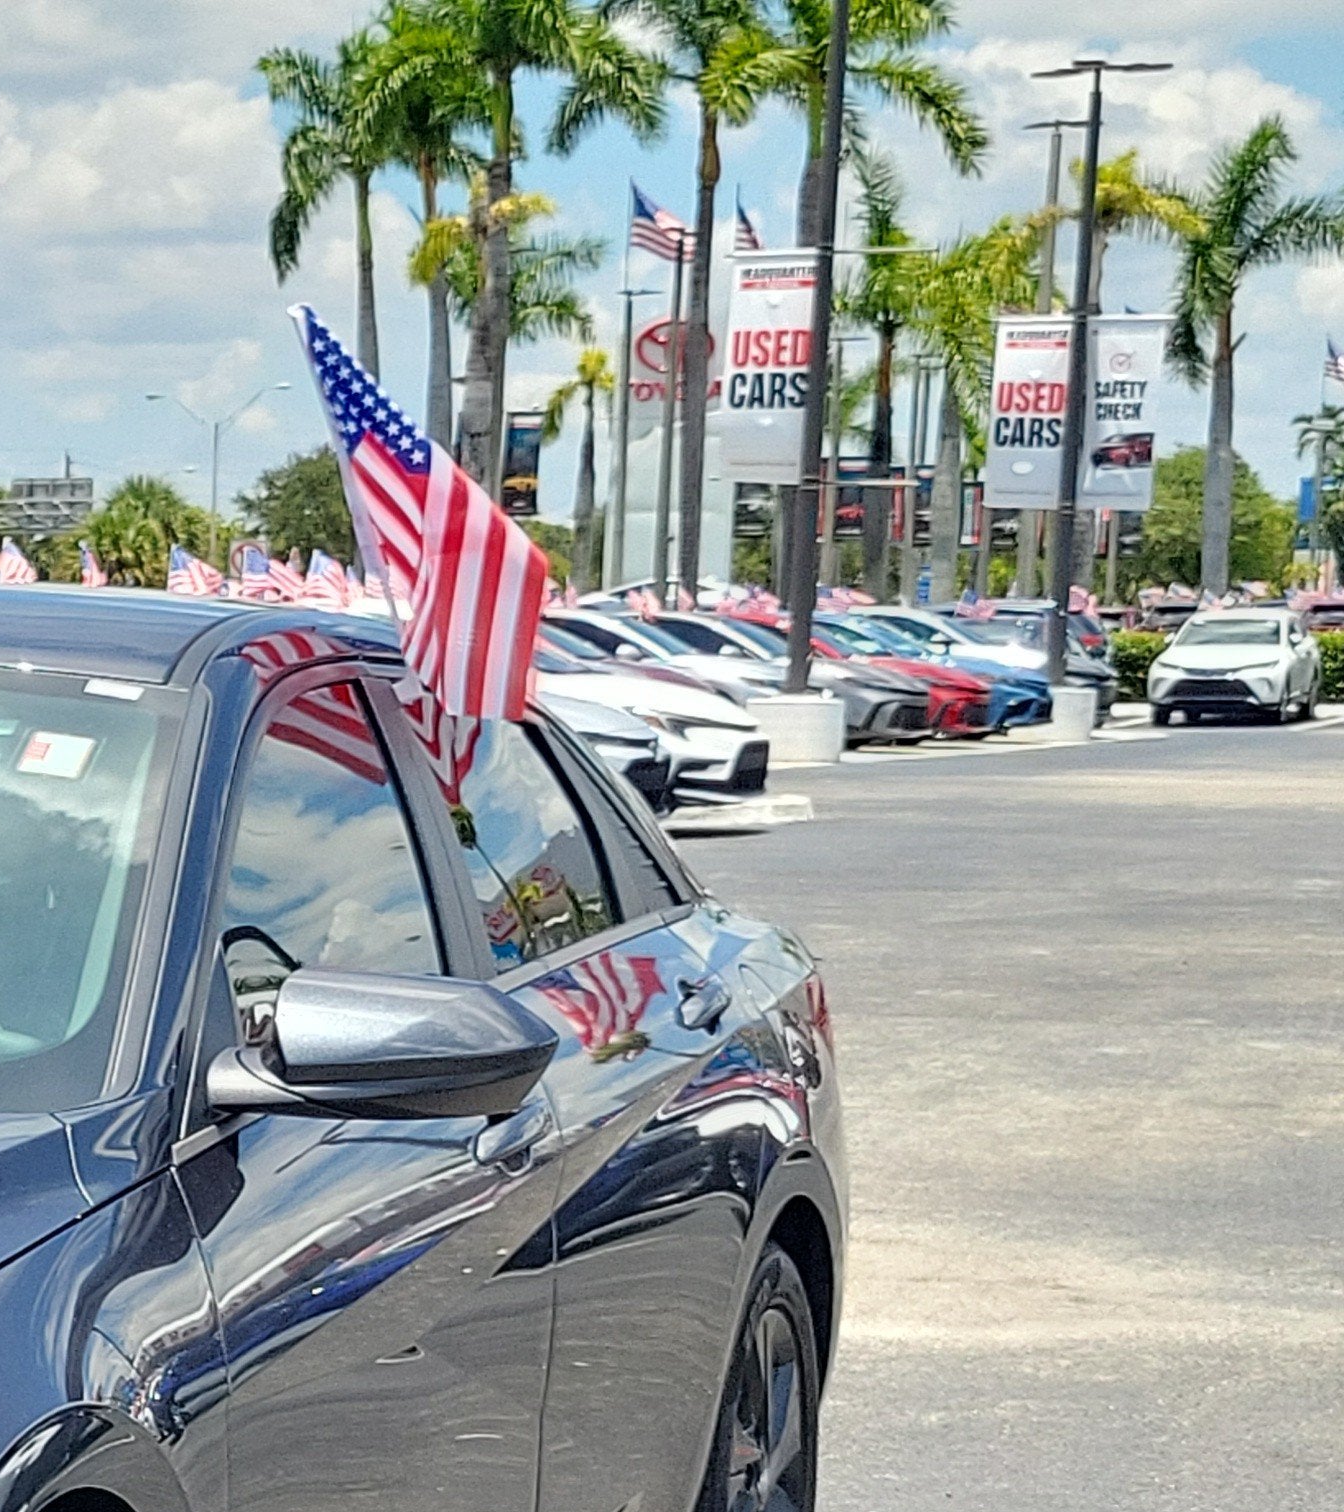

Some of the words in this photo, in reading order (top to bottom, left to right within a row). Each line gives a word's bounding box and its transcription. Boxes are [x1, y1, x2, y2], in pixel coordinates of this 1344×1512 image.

[732, 329, 813, 367] USED
[729, 372, 809, 409] CARS
[996, 381, 1065, 413] USED
[1094, 379, 1148, 400] SAFETY
[1094, 401, 1143, 421] CHECK
[994, 417, 1062, 448] CARS
